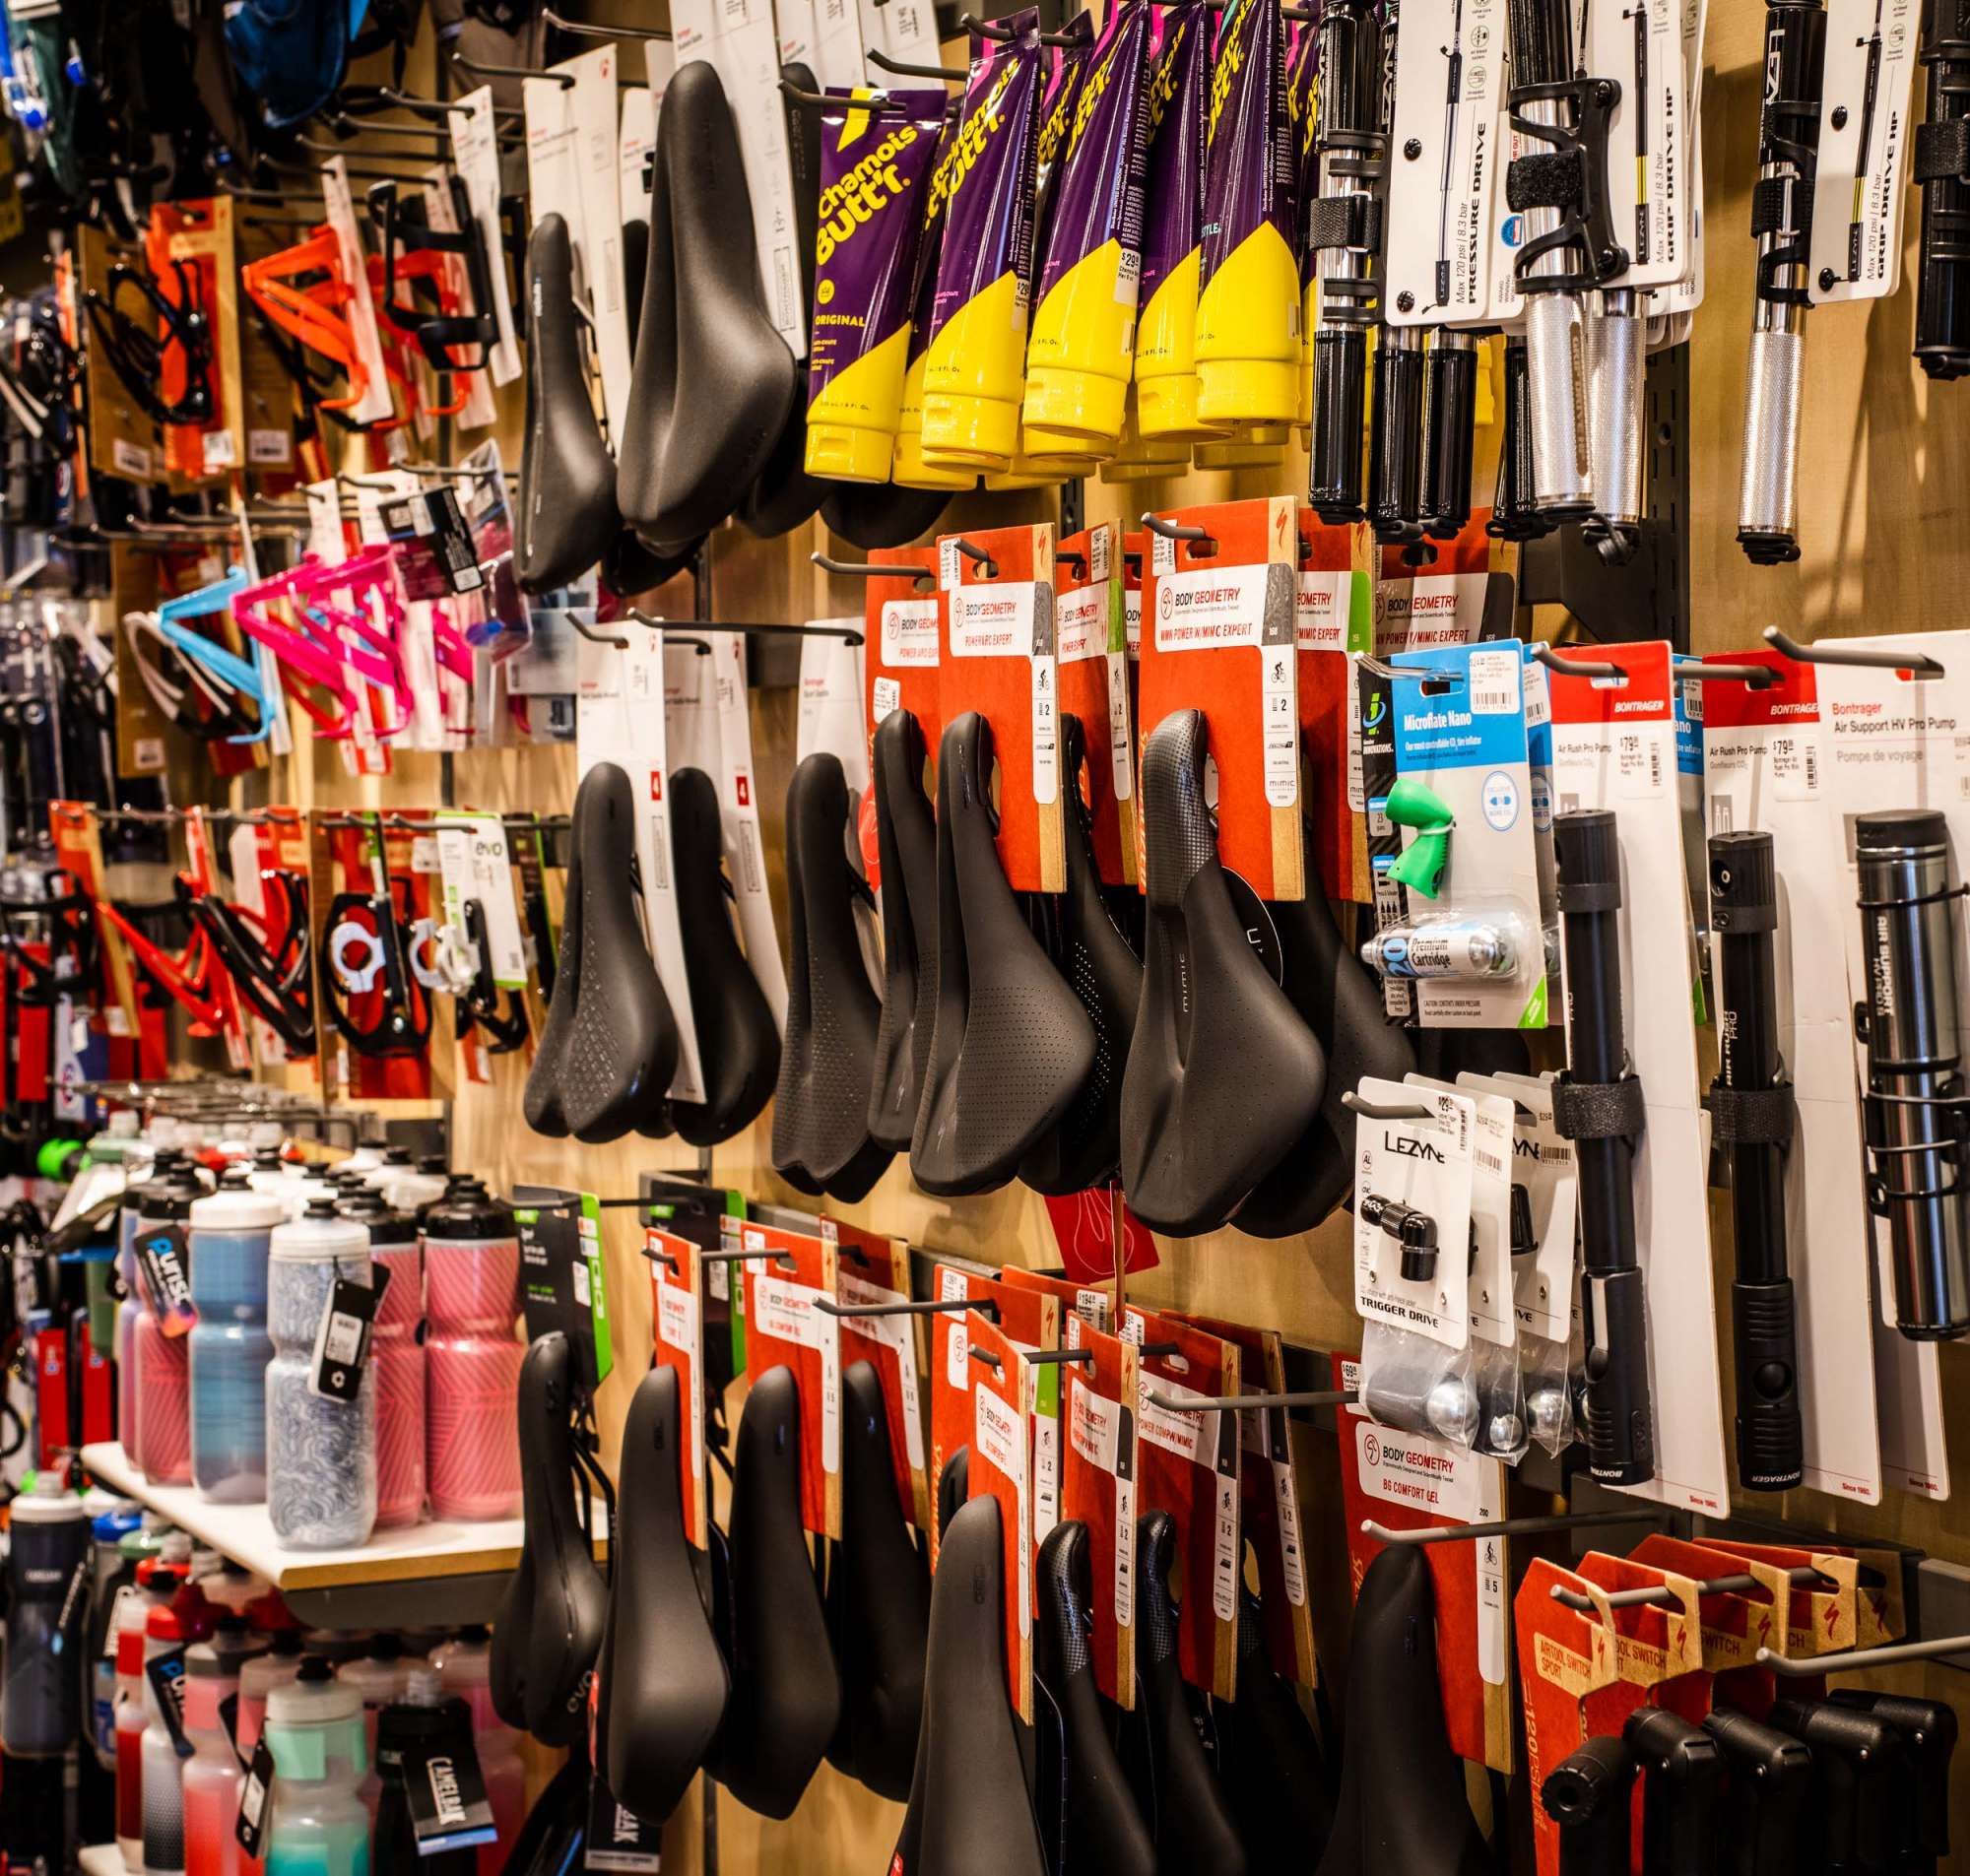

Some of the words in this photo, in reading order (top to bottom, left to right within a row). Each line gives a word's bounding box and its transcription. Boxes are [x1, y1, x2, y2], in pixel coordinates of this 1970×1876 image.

[1666, 87, 1674, 116] HP
[1473, 122, 1486, 192] DRIVE
[1881, 145, 1894, 218] DRIVE
[1889, 110, 1898, 140] HP
[1872, 172, 1881, 190] bar
[1458, 203, 1469, 218] bar
[1657, 199, 1666, 215] psi
[1458, 220, 1468, 236] 8.3
[1656, 217, 1665, 235] 120
[1870, 219, 1878, 233] psi
[1457, 244, 1467, 259] psi
[1469, 198, 1479, 303] PRESSURE
[1656, 239, 1665, 263] Max
[1457, 261, 1466, 278] 120
[1867, 258, 1876, 280] Max
[1456, 281, 1466, 303] Max
[815, 315, 865, 327] ORIGINAL
[1175, 592, 1194, 607] BODY
[1194, 588, 1241, 604] GEOMETRY
[1297, 592, 1332, 606] EOMETRY
[1388, 598, 1409, 612] BODY
[965, 604, 981, 615] BODY
[981, 602, 1017, 615] GEOMETRY
[1126, 610, 1141, 621] ODY
[901, 618, 917, 630] BODY
[1173, 627, 1193, 640] POWER
[1222, 622, 1252, 636] EXPERT
[992, 633, 1013, 646] EXPERT
[1317, 627, 1341, 641] EXPERT
[1385, 633, 1408, 645] POWER
[1439, 629, 1469, 642] EXPERT
[899, 647, 916, 659] POWER
[1044, 704, 1050, 715] 2
[1280, 699, 1286, 711] 2
[1614, 700, 1665, 712] BONTRAGER
[1832, 702, 1882, 716] Bontrager
[1404, 714, 1448, 732] Microflate
[1448, 711, 1472, 726] Nano
[1674, 722, 1691, 734] ano
[1834, 720, 1848, 733] Air
[1850, 719, 1890, 735] Support
[1891, 718, 1906, 730] HV
[1908, 717, 1926, 730] Pro
[1928, 716, 1956, 731] Pump
[1567, 744, 1582, 753] Rush
[1583, 744, 1594, 753] Pro
[1595, 743, 1612, 754] Pump
[1710, 746, 1719, 756] Air
[1720, 745, 1736, 756] Rush
[1737, 745, 1747, 755] Pro
[1749, 745, 1768, 755] Pump
[1836, 749, 1871, 764] Pompe
[1873, 749, 1885, 761] de
[1887, 749, 1924, 763] voyage
[652, 778, 659, 795] 4
[739, 782, 747, 800] 4
[1876, 916, 1888, 942] AIR
[1411, 952, 1451, 968] Cartridge
[1873, 957, 1882, 976] HV
[1879, 944, 1894, 1016] SUPPORT
[1874, 977, 1884, 1004] PRO
[1729, 1010, 1739, 1040] PRO
[1384, 1131, 1445, 1164] LEZYNE
[1360, 1296, 1407, 1318] TRIGGER
[1409, 1309, 1439, 1328] DRIVE
[1047, 1460, 1052, 1471] 2
[1383, 1446, 1405, 1462] BODY
[1406, 1453, 1454, 1474] GEOMETRY
[1383, 1478, 1392, 1492] BG
[1393, 1482, 1424, 1502] COMFORT
[1842, 1482, 1856, 1493] Since
[1689, 1495, 1704, 1506] Since
[1286, 1511, 1292, 1522] 2
[1478, 1508, 1489, 1518] 200
[1226, 1524, 1231, 1536] 2
[1492, 1580, 1498, 1593] 5
[1541, 1640, 1566, 1666] AIRTOOL
[1566, 1653, 1592, 1680] SWITCH
[1542, 1656, 1562, 1676] SPORT
[1632, 1648, 1668, 1672] SWITCH
